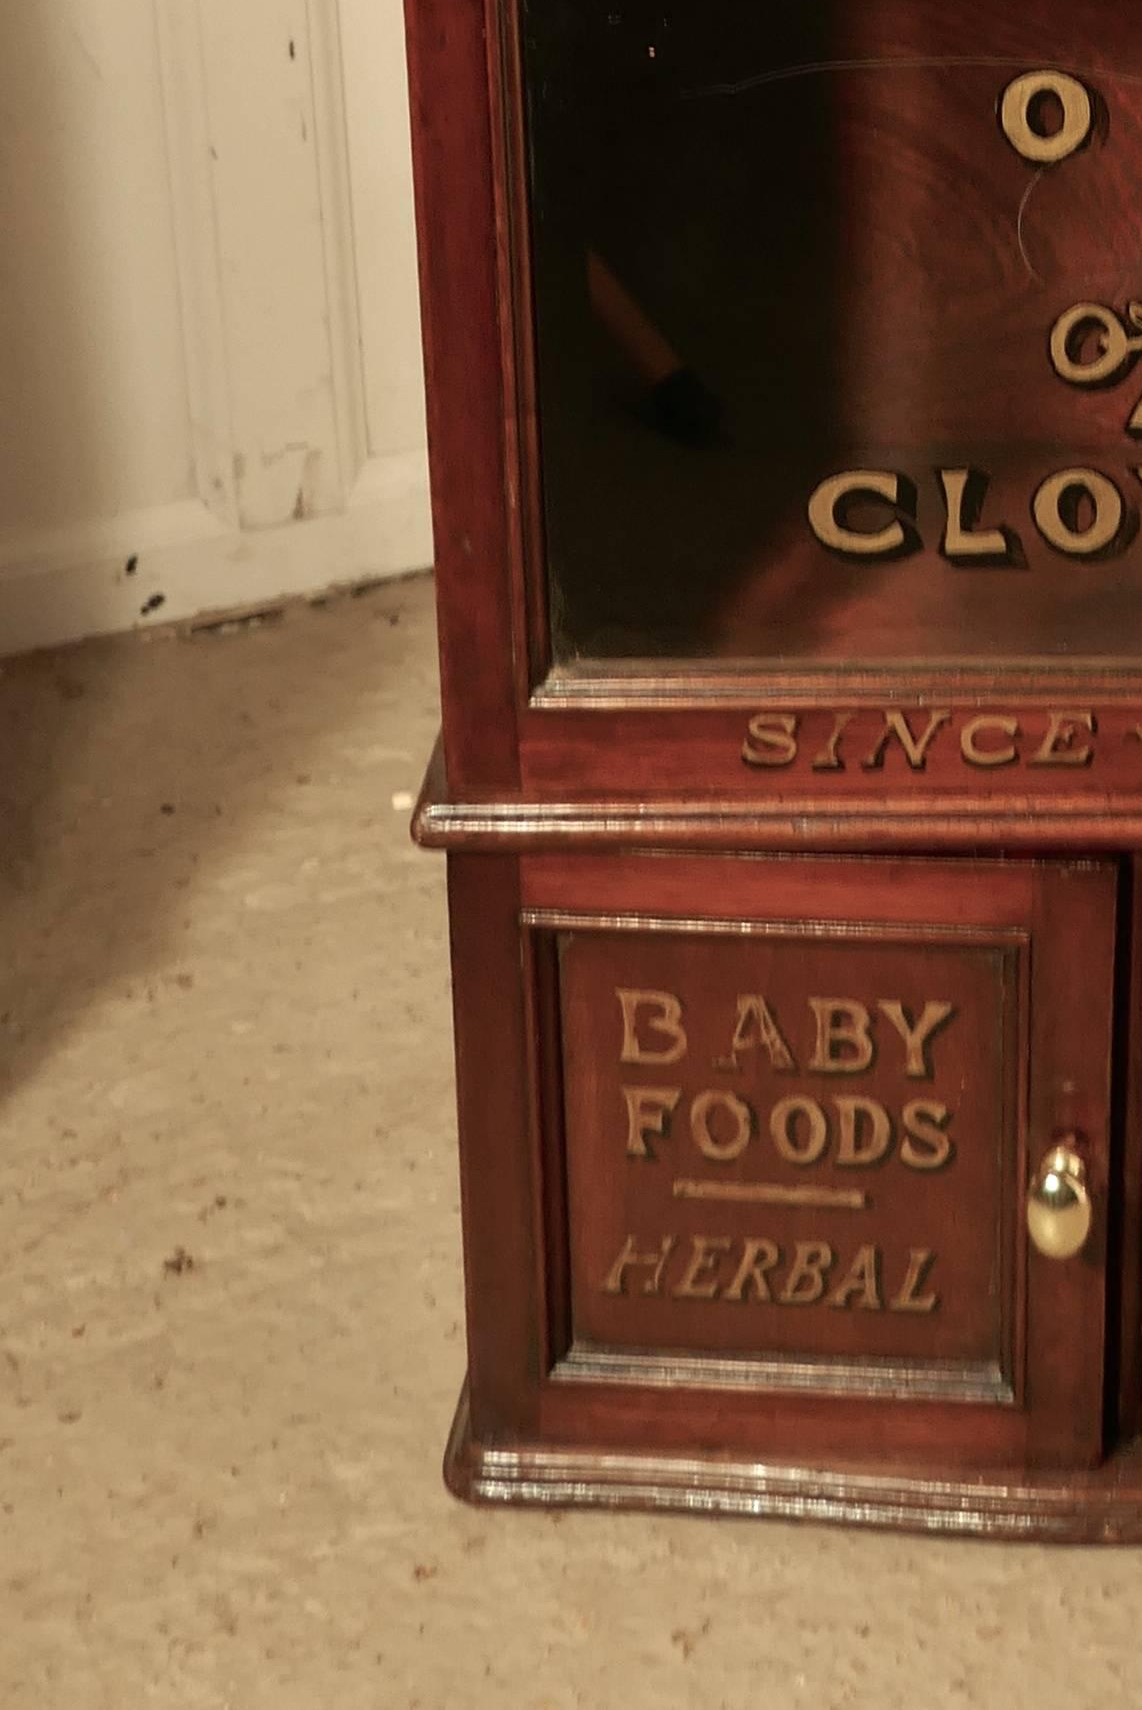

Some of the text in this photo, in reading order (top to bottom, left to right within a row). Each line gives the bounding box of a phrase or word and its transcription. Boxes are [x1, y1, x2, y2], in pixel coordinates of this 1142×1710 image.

[742, 710, 1099, 770] SINCE
[615, 988, 953, 1078] BABY
[622, 1086, 952, 1169] FOODS
[604, 1234, 938, 1312] HERBAL
